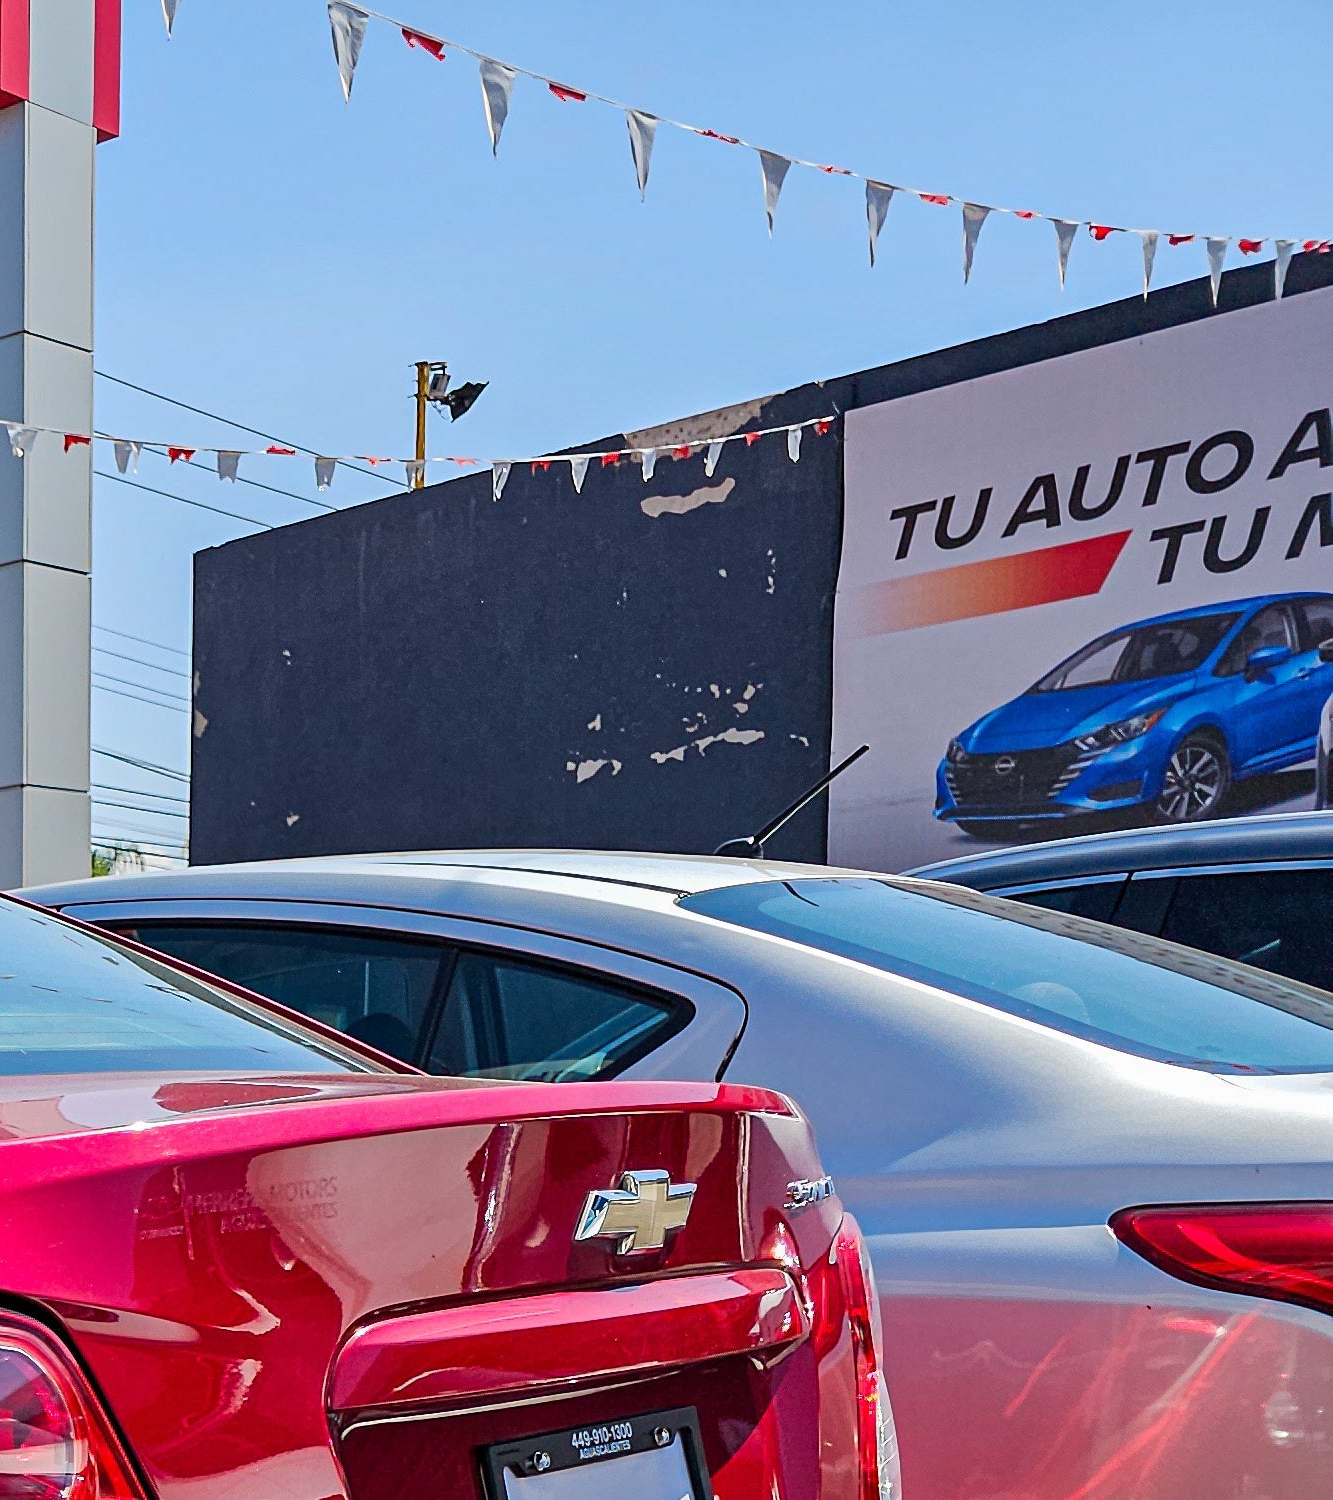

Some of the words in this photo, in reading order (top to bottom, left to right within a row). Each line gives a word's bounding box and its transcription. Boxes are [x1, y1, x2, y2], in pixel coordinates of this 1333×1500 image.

[889, 487, 993, 561] TU
[1001, 430, 1255, 538] AUTO
[1267, 408, 1333, 480] A
[1149, 505, 1272, 585] TU
[571, 1421, 633, 1449] 449-910-1300
